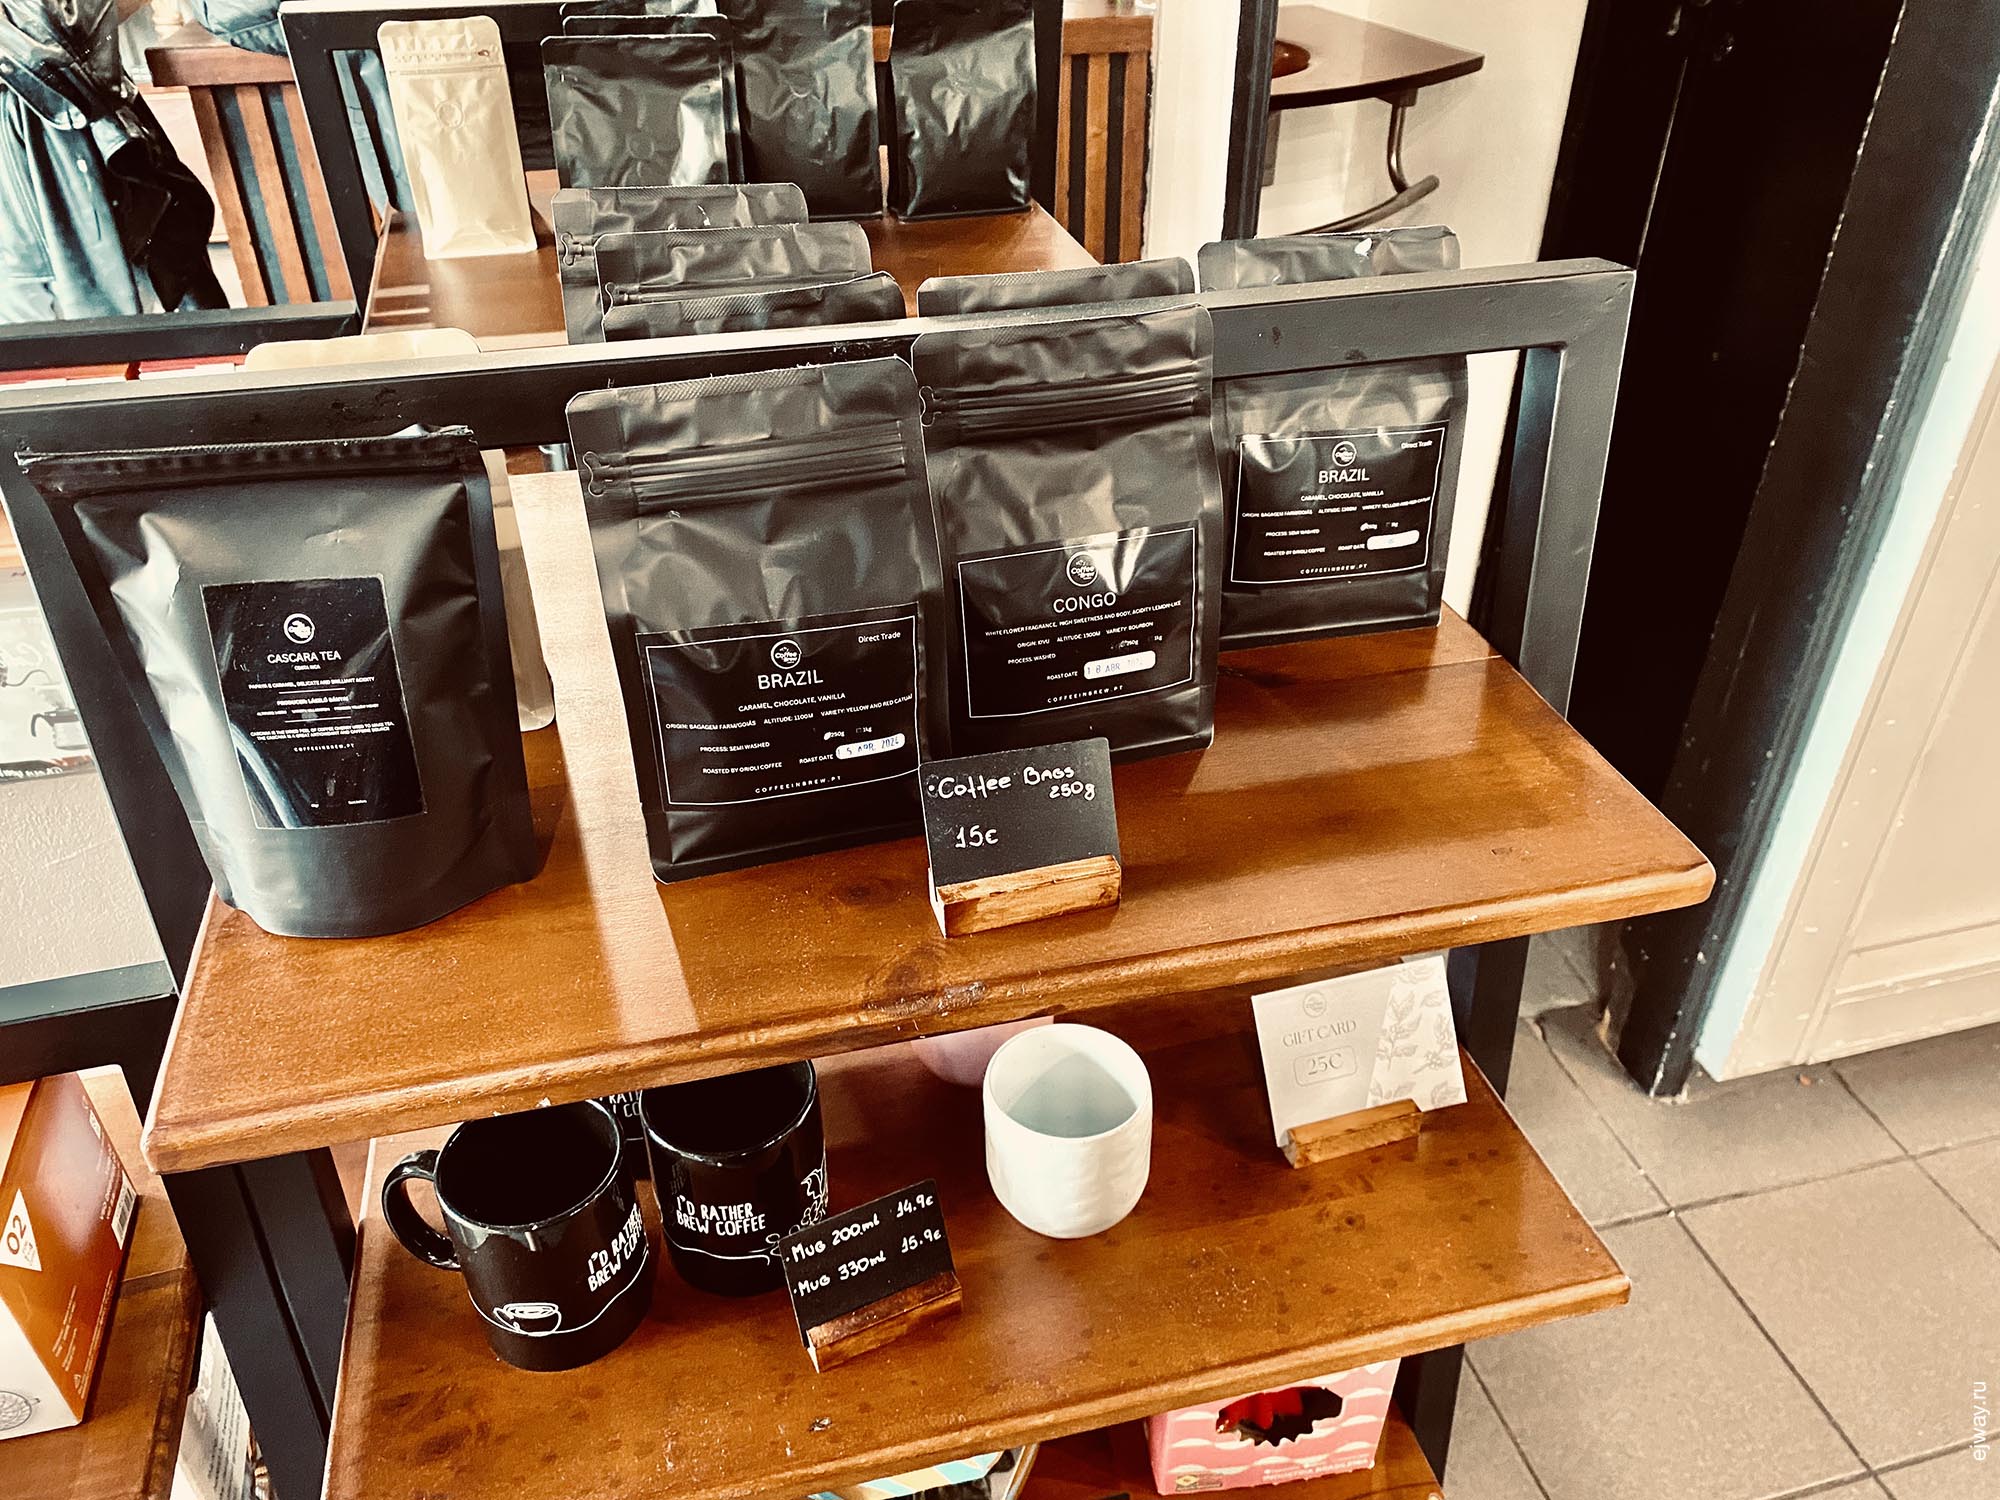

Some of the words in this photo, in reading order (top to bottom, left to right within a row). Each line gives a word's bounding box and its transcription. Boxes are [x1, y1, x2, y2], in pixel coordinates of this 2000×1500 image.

[1318, 467, 1370, 484] BRAZIL
[1052, 591, 1117, 614] CONGO
[858, 634, 880, 643] Direct
[881, 631, 901, 640] Trade
[267, 652, 318, 664] CASCARA
[319, 650, 341, 661] TEA
[757, 669, 824, 690] BRAZIL
[738, 702, 773, 712] CARAMEL,
[774, 696, 817, 708] CHOCOLATE,
[817, 692, 846, 702] VANILLA
[1047, 684, 1124, 704] COFFEEINBREW.PT
[744, 741, 770, 750] WASHED
[702, 767, 730, 775] ROASTED
[760, 761, 783, 770] COFFEE
[799, 756, 818, 764] ROAST
[754, 775, 841, 794] COFFEEINBREW.PT
[937, 774, 1012, 799] Coffee
[1049, 781, 1096, 801] 250g
[1282, 1028, 1315, 1048] GIFT
[1317, 1020, 1357, 1040] CARD
[676, 1194, 696, 1216] I'D
[700, 1202, 754, 1221] RATHER
[676, 1210, 709, 1235] BREW
[716, 1213, 766, 1236] COFFEE
[831, 1212, 880, 1246] 200ml
[588, 1249, 609, 1275] I'D
[837, 1250, 887, 1281] 330ml
[588, 1253, 622, 1292] BREW
